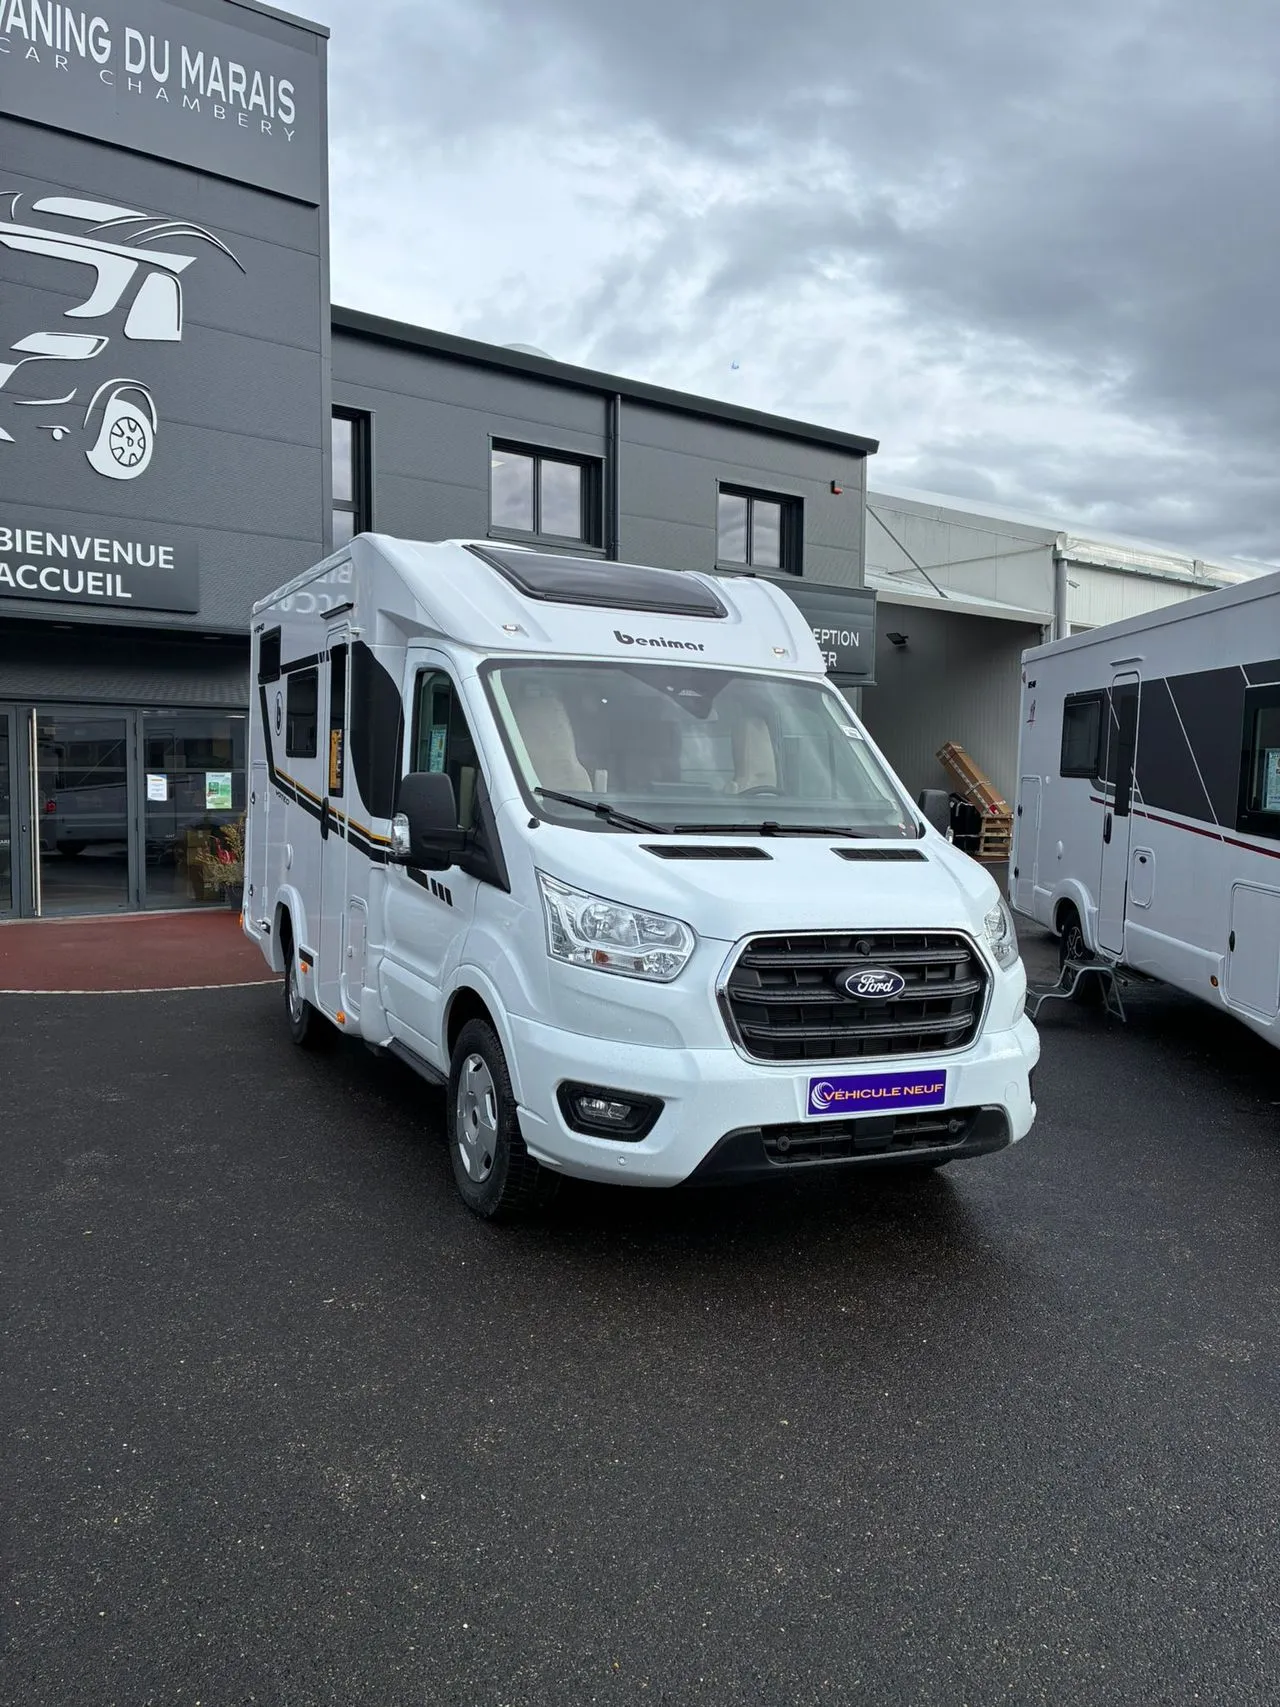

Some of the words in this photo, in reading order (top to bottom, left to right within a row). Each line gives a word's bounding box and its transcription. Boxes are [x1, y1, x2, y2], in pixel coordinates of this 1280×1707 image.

[125, 26, 170, 83] DU
[181, 45, 296, 125] MARAIS
[99, 69, 296, 142] CHAMBERY
[0, 526, 175, 570] BIENVENUE
[0, 562, 132, 599] ACCUEIL
[613, 630, 704, 651] benimar
[857, 974, 894, 993] Ford
[823, 1087, 902, 1101] VÉHICULE
[903, 1083, 944, 1096] NEUF
